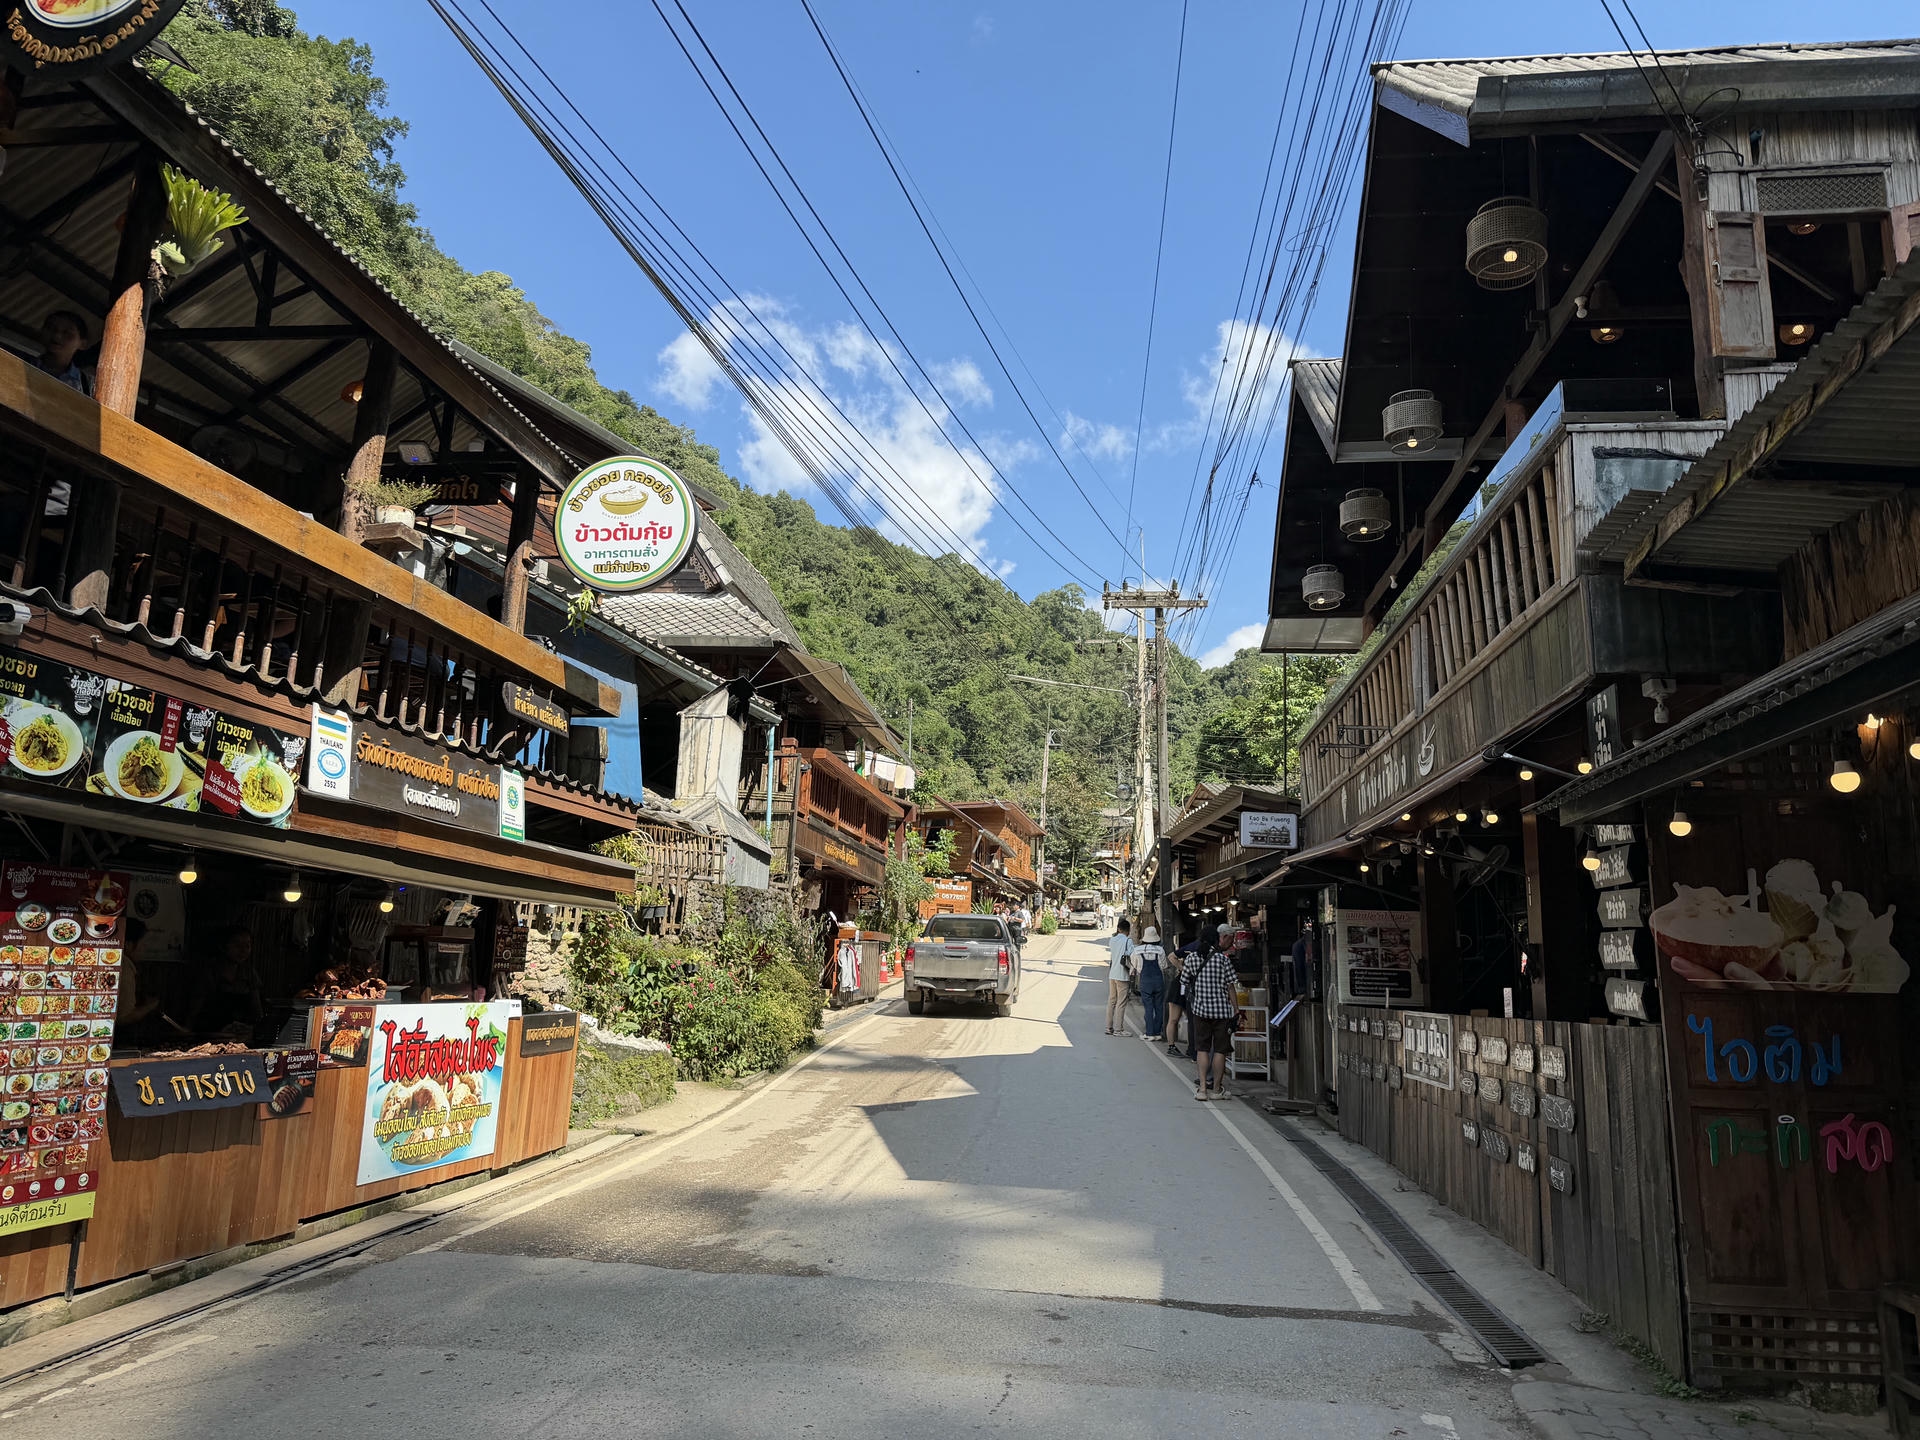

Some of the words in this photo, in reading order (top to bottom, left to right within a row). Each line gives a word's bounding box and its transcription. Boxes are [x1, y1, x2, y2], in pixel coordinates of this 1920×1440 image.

[568, 469, 620, 513] ข้าวซอย
[624, 469, 674, 505] กลอยใจ
[575, 520, 672, 546] ข้าวต้มกุ้ย
[584, 544, 659, 559] อาหารตามสั่ง
[593, 560, 650, 574] แม่กำปอง
[107, 685, 155, 714] ข้าวซอย
[216, 716, 254, 741] ข้าวซอย
[319, 737, 344, 750] THAILAND
[324, 779, 337, 789] 2552
[380, 1016, 500, 1091] ไส้อั่วสมุนไพร
[1686, 1013, 1843, 1087] ไอติม
[136, 1075, 165, 1106] ช.
[169, 1063, 256, 1102] การย่าง
[1706, 1113, 1810, 1169] กะทิ
[1819, 1112, 1894, 1174] สด
